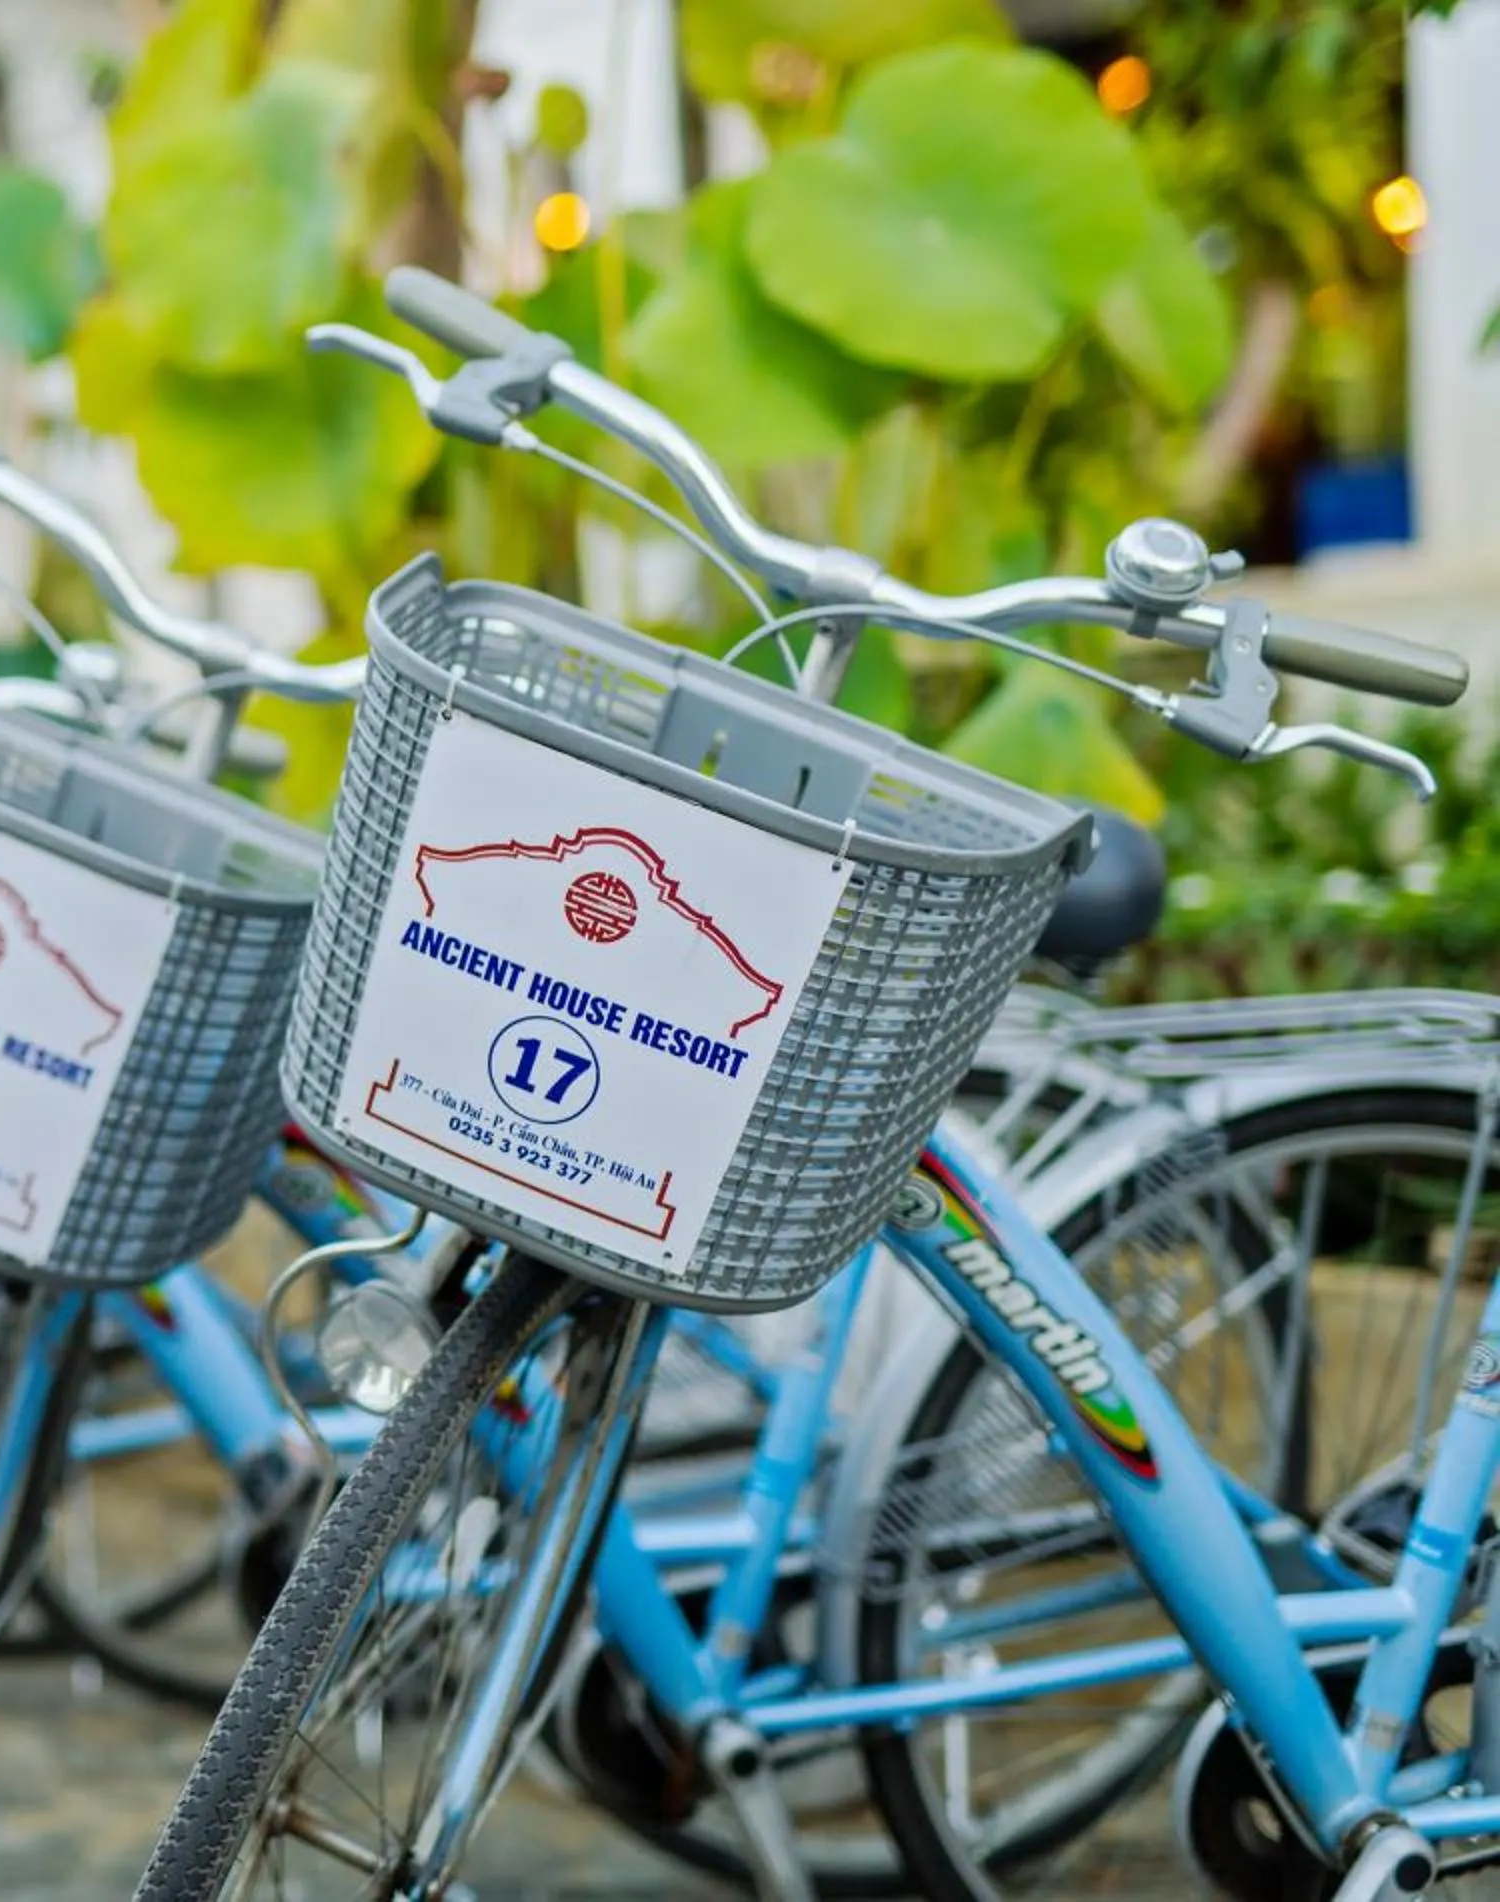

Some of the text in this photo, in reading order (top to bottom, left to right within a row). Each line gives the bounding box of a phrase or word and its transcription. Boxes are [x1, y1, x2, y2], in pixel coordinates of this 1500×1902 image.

[401, 920, 749, 1079] ANCIENT HOUSE RESORT
[504, 1037, 592, 1105] 17
[398, 1073, 424, 1092] 377
[583, 1150, 606, 1173] TP.
[636, 1175, 656, 1192] An
[448, 1116, 594, 1187] 0235 3 923 377
[943, 1237, 1112, 1394] martin
